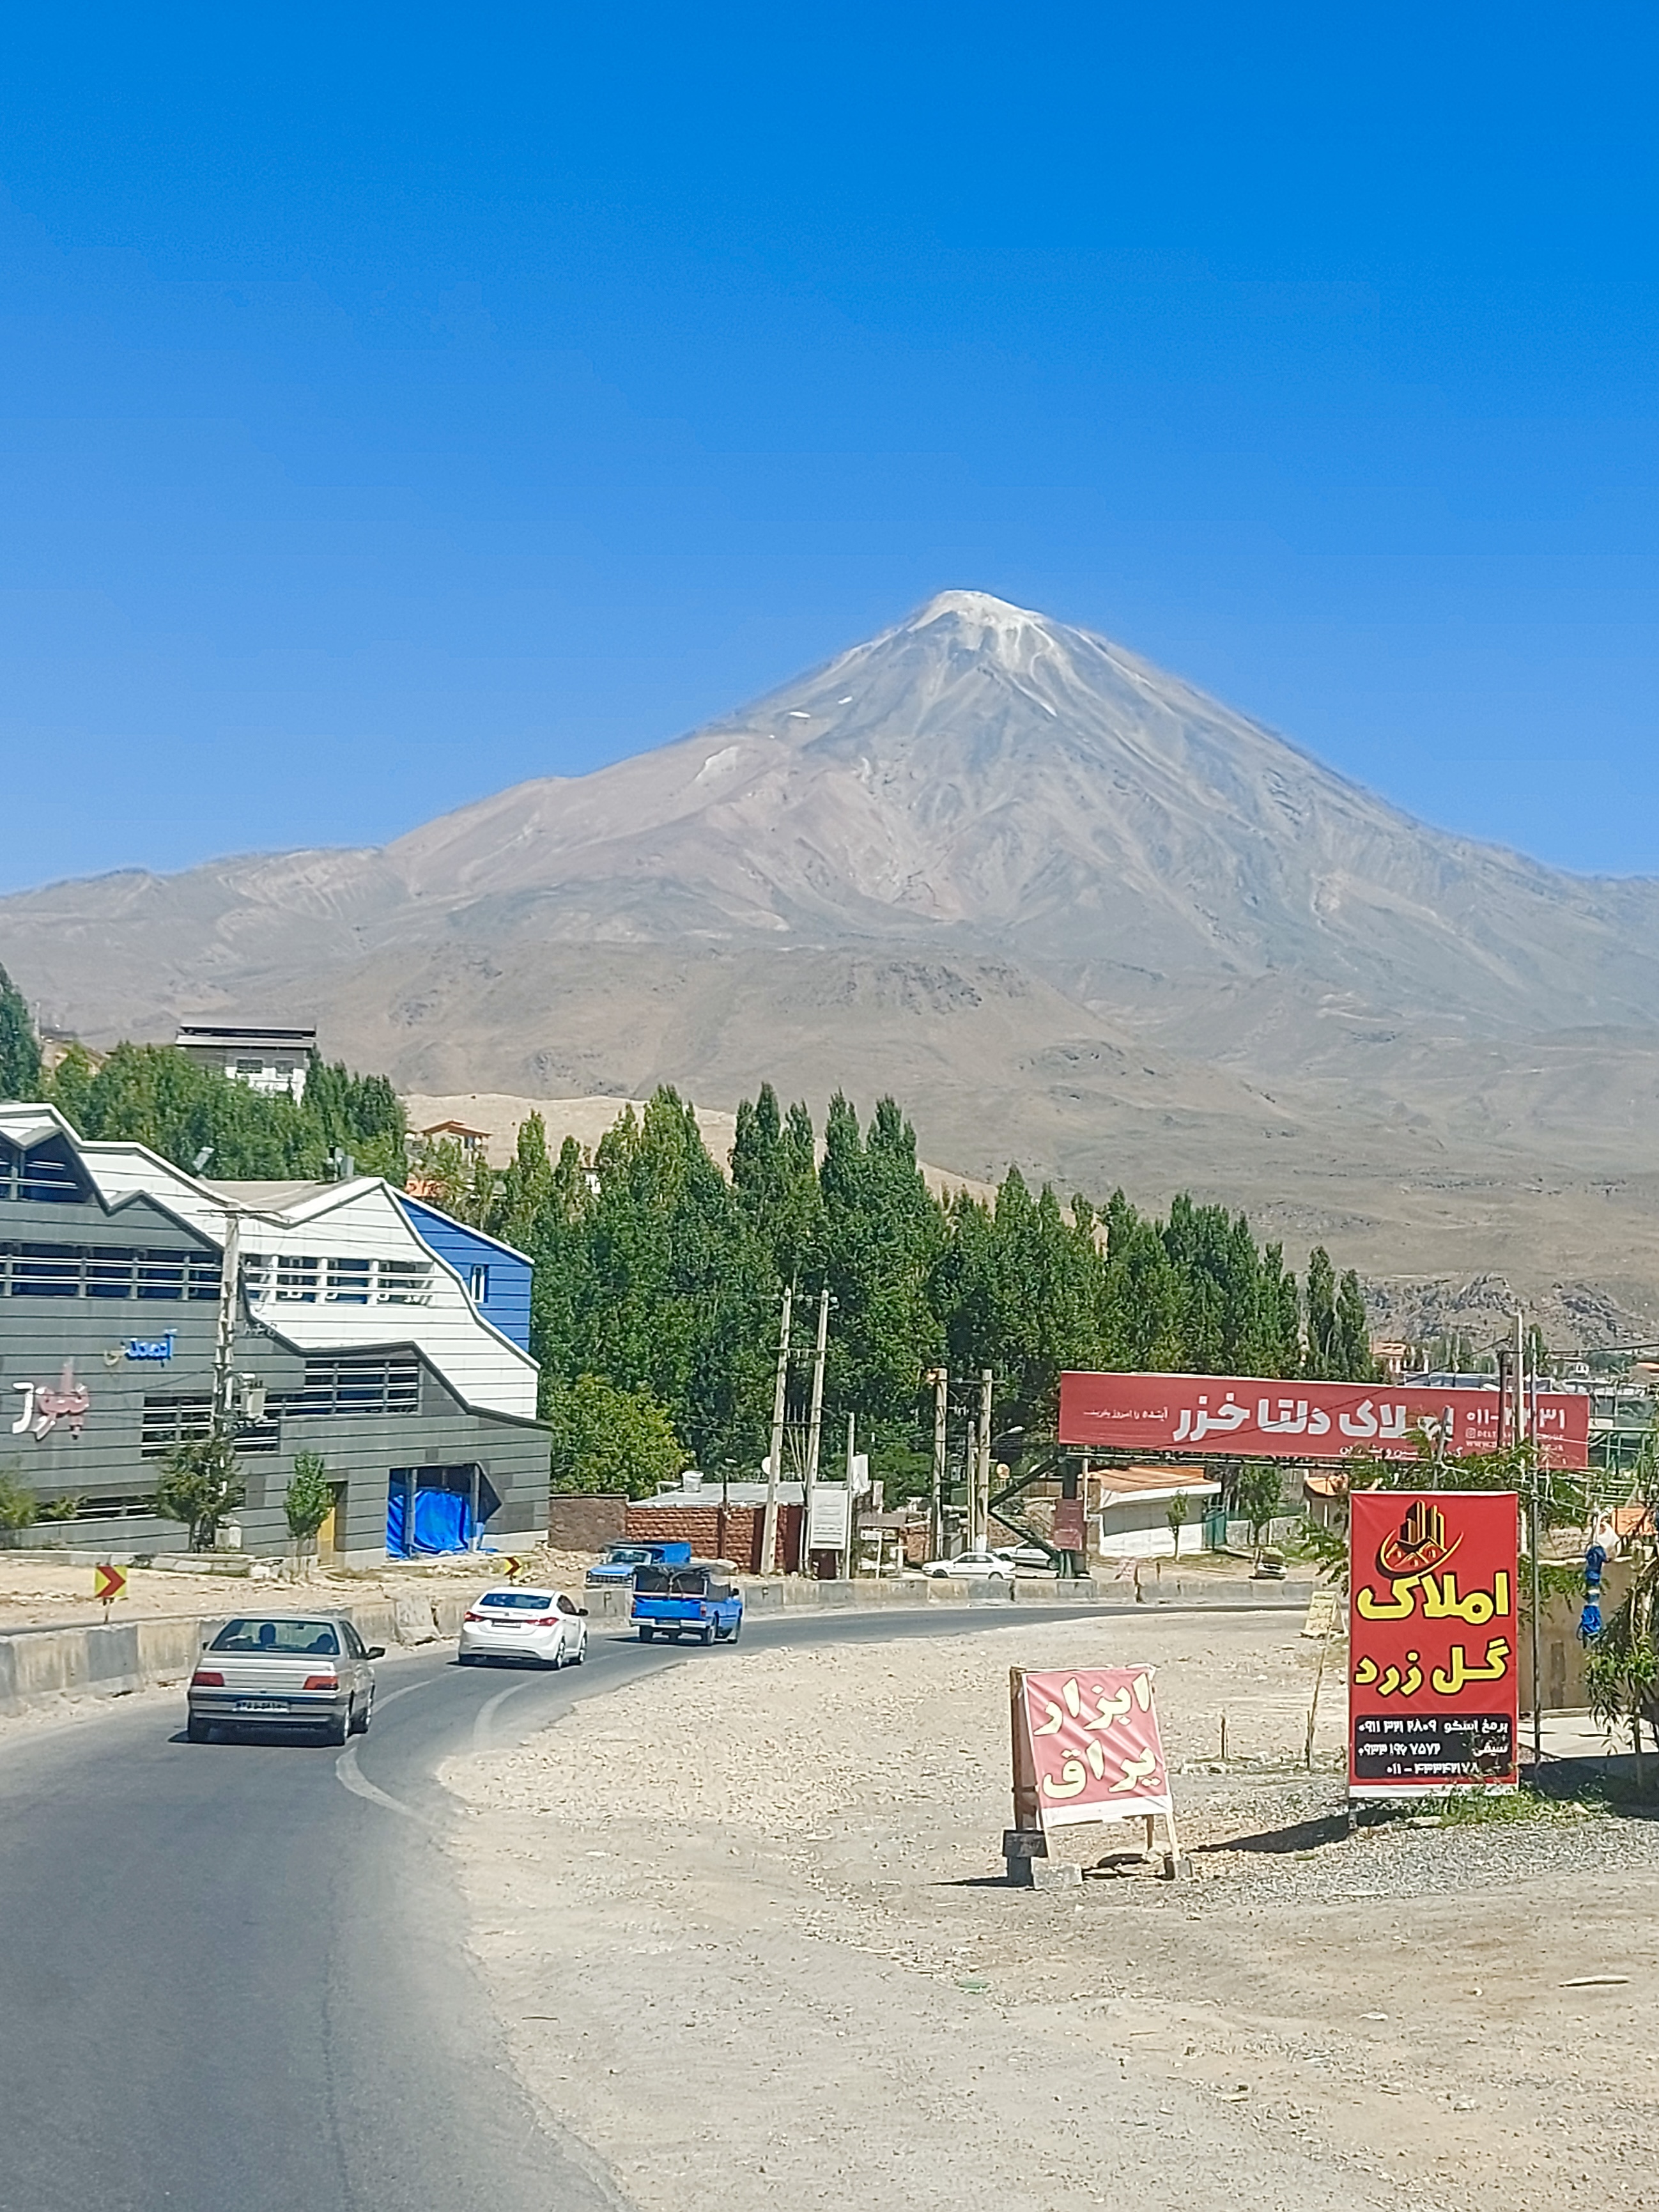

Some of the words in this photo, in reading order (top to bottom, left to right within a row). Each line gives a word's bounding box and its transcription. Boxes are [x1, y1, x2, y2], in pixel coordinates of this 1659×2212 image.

[1172, 1393, 1251, 1442] خزر
[1257, 1398, 1331, 1435] دلتا
[1357, 1572, 1509, 1625] املاک
[1355, 1651, 1422, 1696] زرد
[1432, 1638, 1509, 1694] گل
[1033, 1673, 1150, 1736] ابزار
[1359, 1721, 1380, 1733] ۰۹۱۱
[1042, 1739, 1161, 1800] یراق
